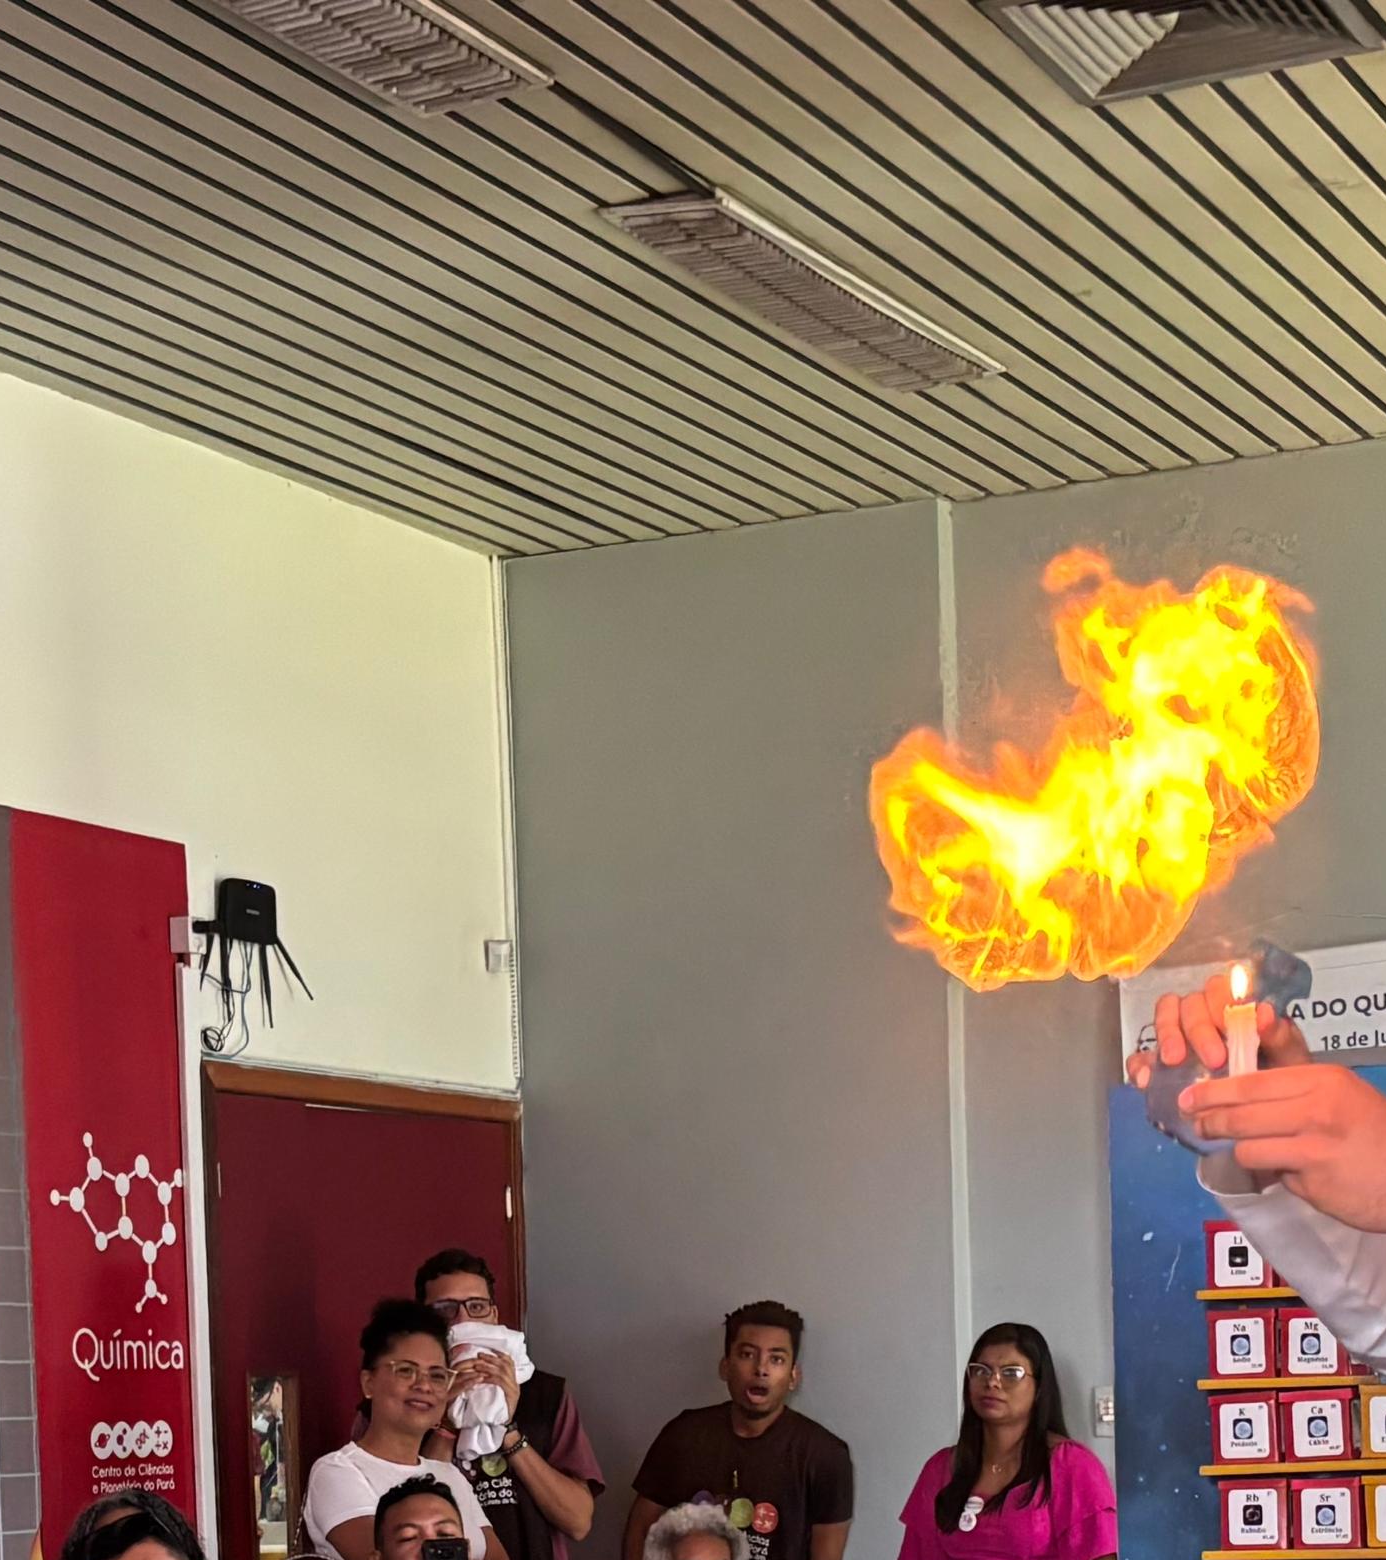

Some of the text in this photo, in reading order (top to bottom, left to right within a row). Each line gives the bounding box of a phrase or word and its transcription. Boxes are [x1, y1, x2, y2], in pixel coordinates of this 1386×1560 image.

[1313, 998, 1347, 1018] DO
[1322, 1035, 1340, 1050] 18
[1347, 1029, 1368, 1048] de
[1233, 1324, 1246, 1332] Na
[1304, 1322, 1319, 1332] Mg
[73, 1328, 184, 1382] Química
[1239, 1408, 1246, 1416] K
[1311, 1407, 1323, 1415] Ca
[92, 1464, 174, 1478] Centro de Ciências
[144, 1481, 155, 1491] do
[157, 1478, 175, 1490] Pará
[1246, 1494, 1259, 1503] Rb
[1319, 1494, 1331, 1503] Sr
